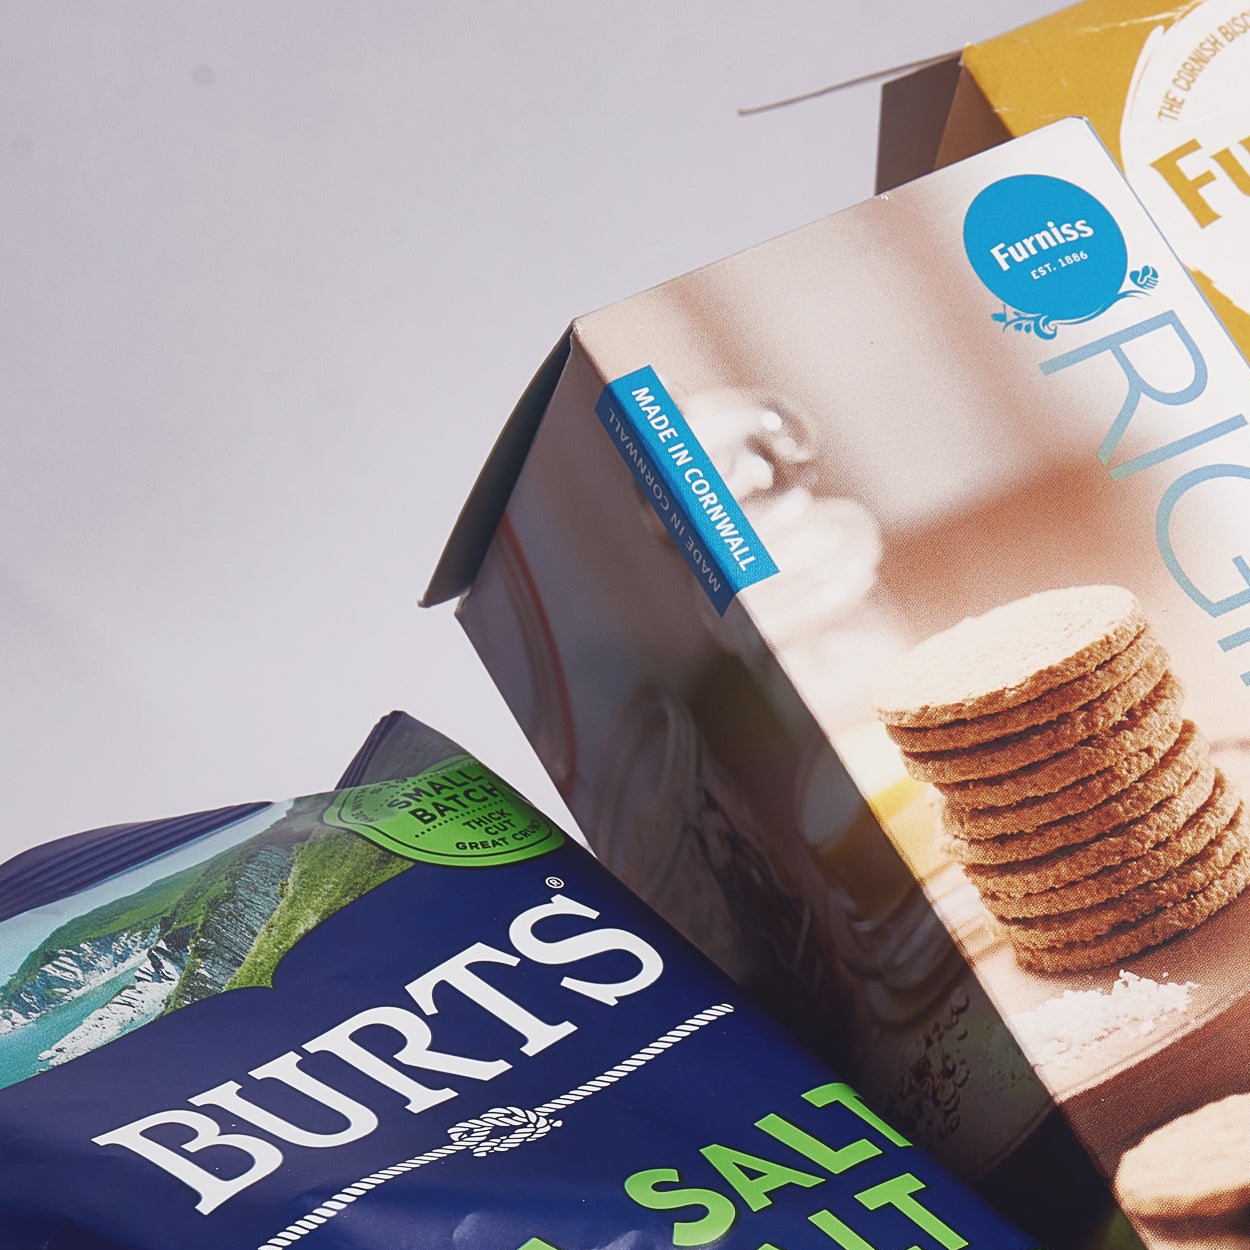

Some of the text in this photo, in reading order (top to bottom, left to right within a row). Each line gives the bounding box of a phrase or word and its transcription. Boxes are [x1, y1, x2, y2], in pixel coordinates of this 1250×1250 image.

[1158, 88, 1186, 122] THE
[1172, 34, 1224, 91] CORNISH
[989, 219, 1094, 272] Furniss
[1030, 250, 1088, 280] EST. 1886
[608, 408, 721, 592] MADE IN CORNWALL
[631, 386, 756, 571] MADE IN CORNWALL
[387, 770, 485, 809] SMALL
[408, 782, 500, 825] BATCH
[462, 808, 512, 830] THICK
[484, 819, 516, 835] CUT
[455, 837, 510, 850] GREAT
[624, 1082, 913, 1247] SALT
